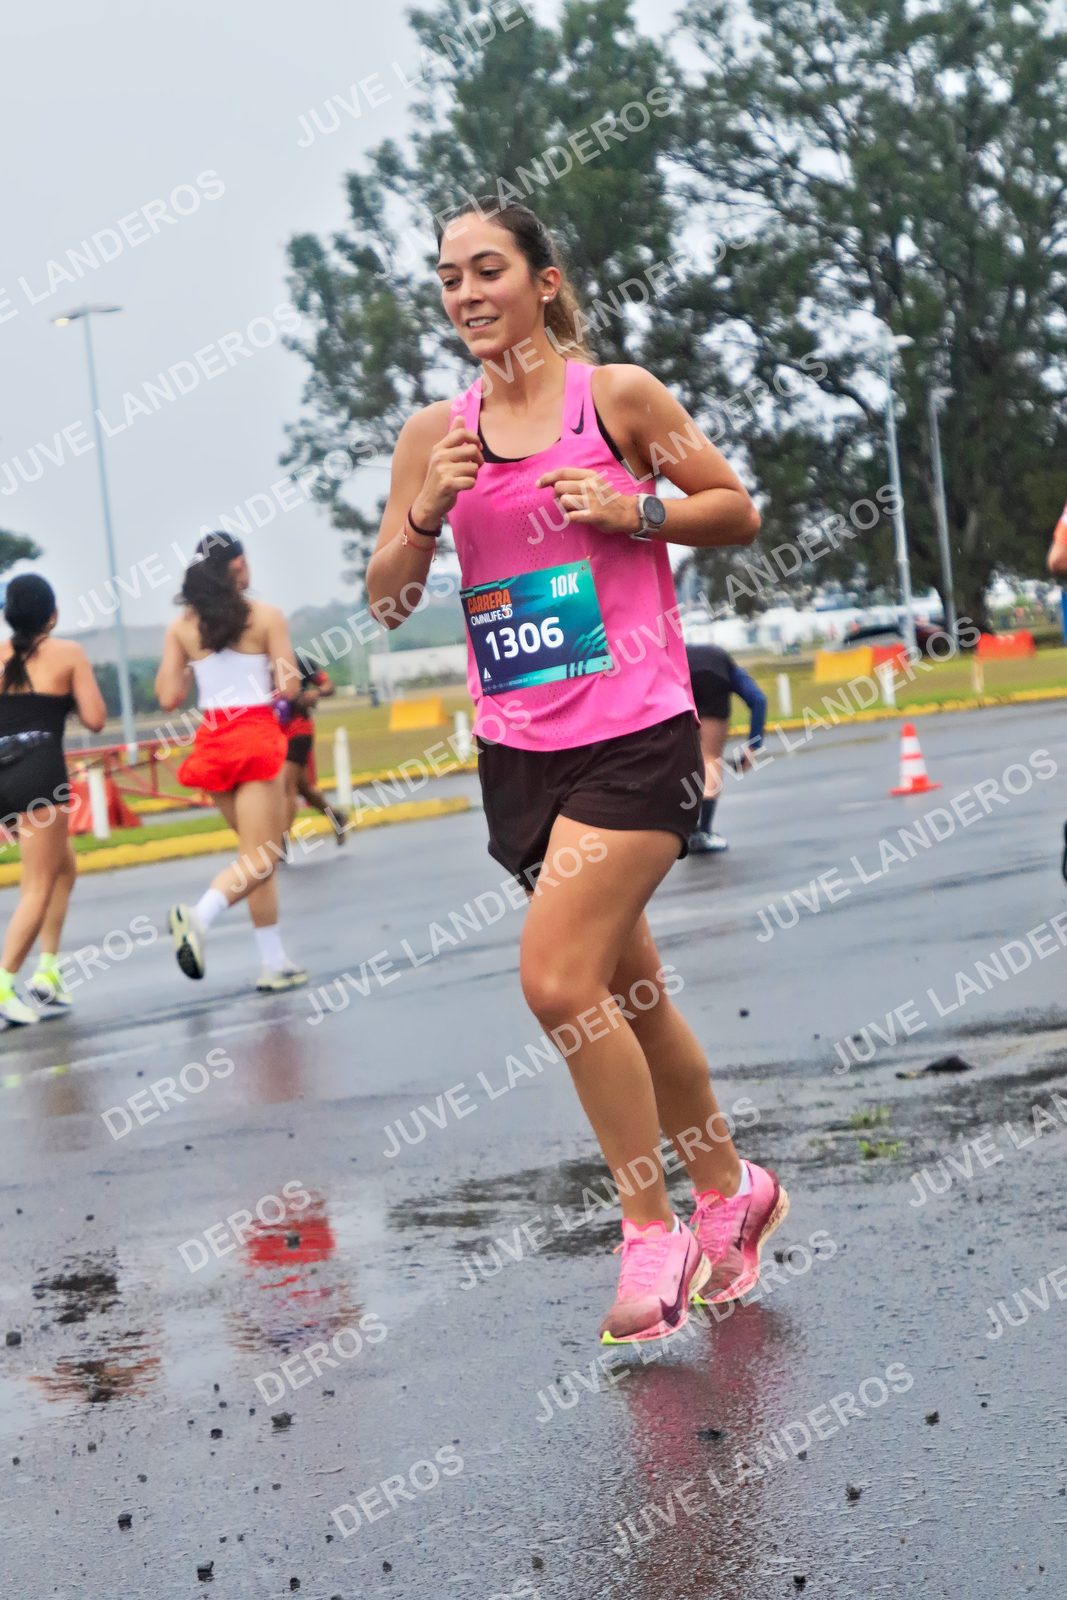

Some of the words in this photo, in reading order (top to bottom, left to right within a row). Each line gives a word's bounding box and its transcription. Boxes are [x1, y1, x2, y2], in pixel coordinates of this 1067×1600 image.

[550, 572, 579, 598] 10K
[467, 588, 511, 614] CARRERA
[470, 609, 503, 626] OMNILIFE
[485, 617, 564, 660] 1306
